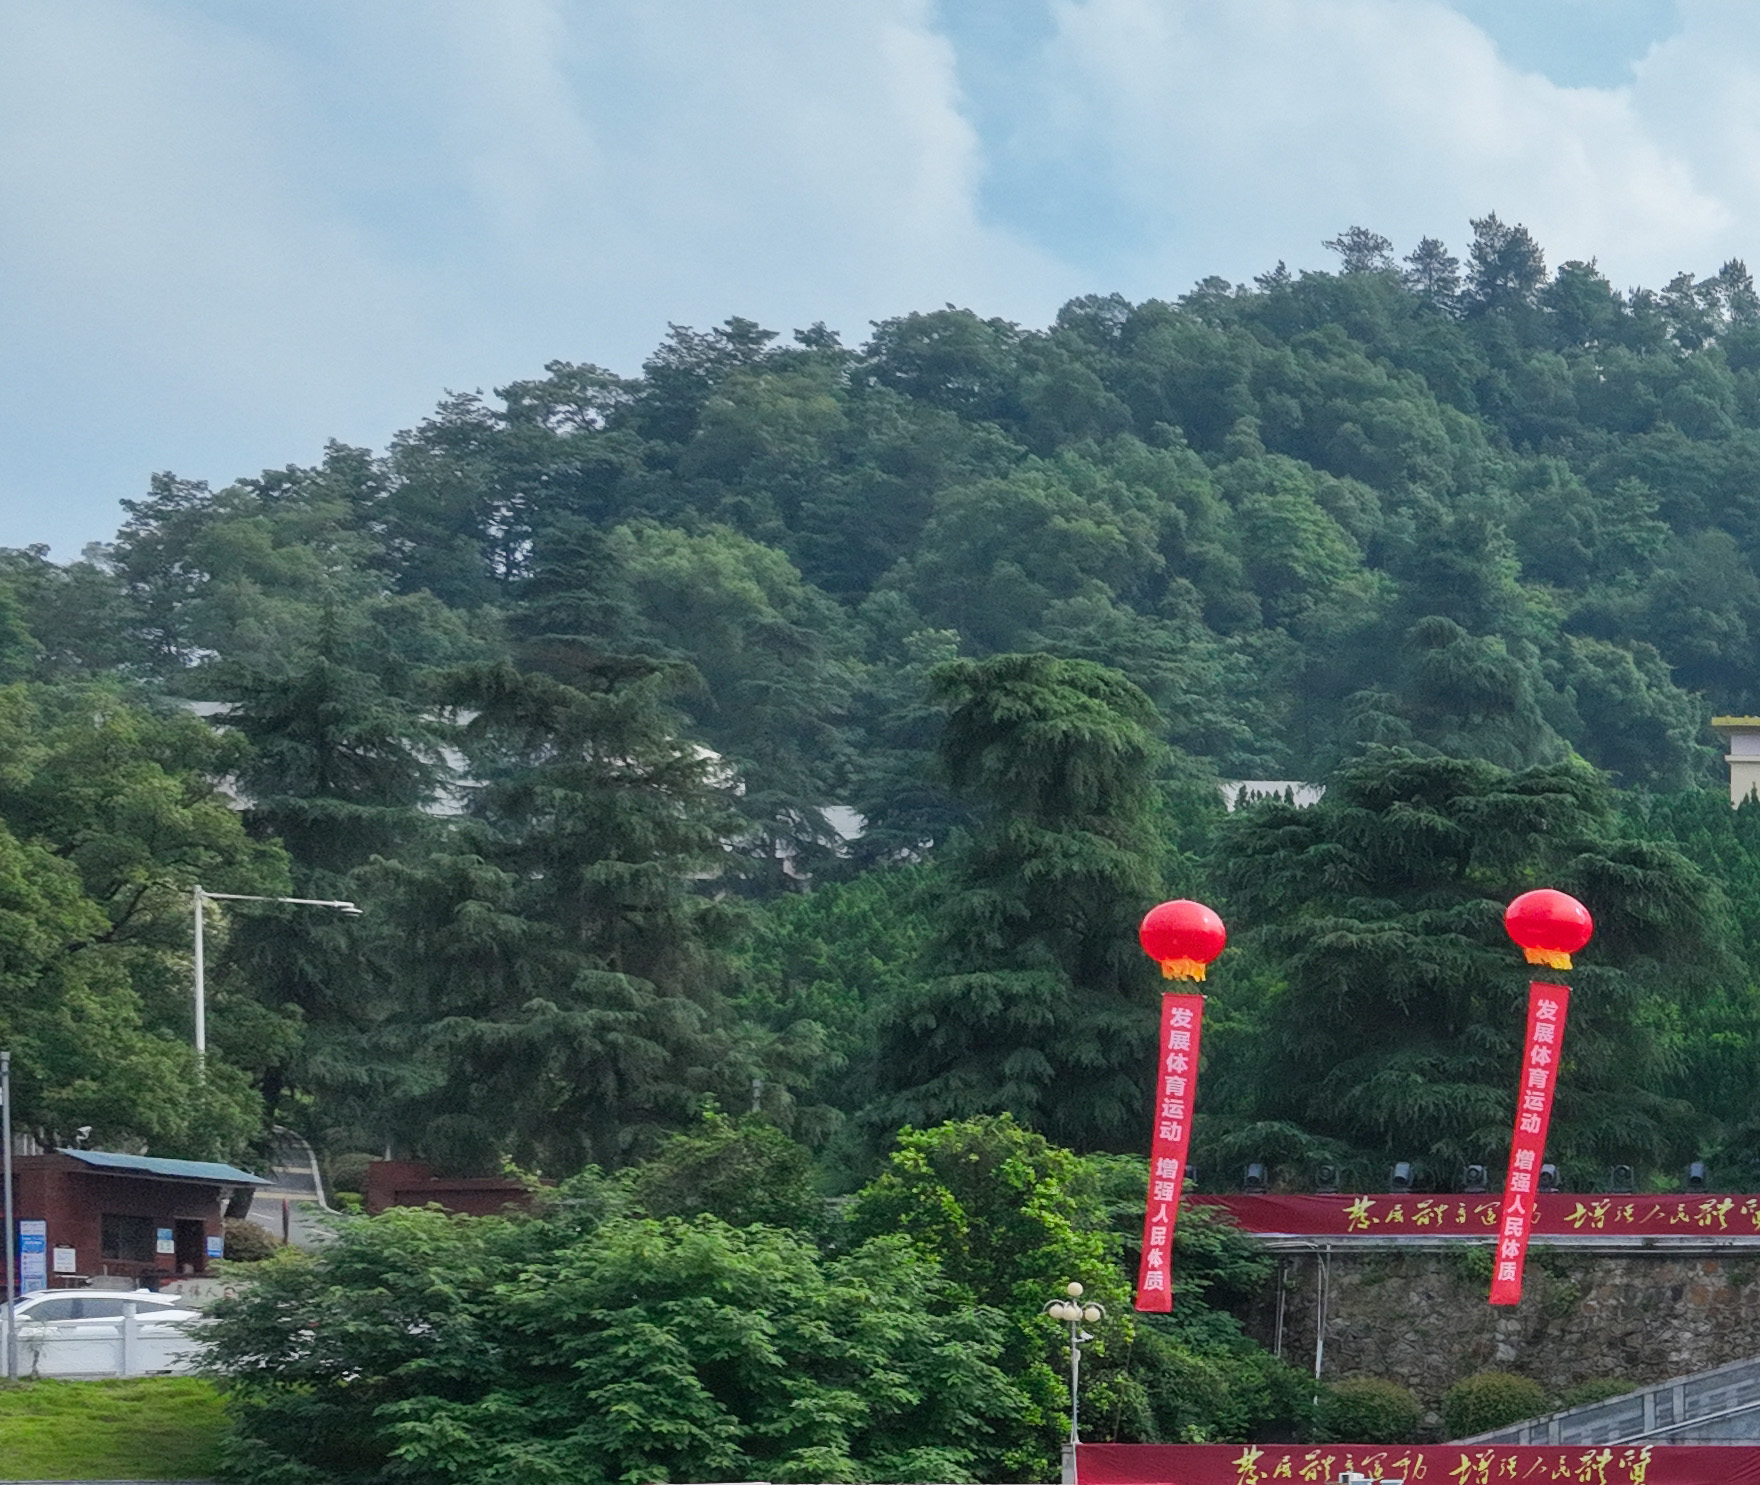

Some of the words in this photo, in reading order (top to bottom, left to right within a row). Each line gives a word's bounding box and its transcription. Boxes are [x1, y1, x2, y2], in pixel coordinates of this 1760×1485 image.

[1160, 1007, 1194, 1142] 发展体育运动
[1519, 1000, 1558, 1133] 发展体育运动
[1143, 1158, 1178, 1290] 增强人民体质
[1498, 1149, 1535, 1281] 增强人民体质
